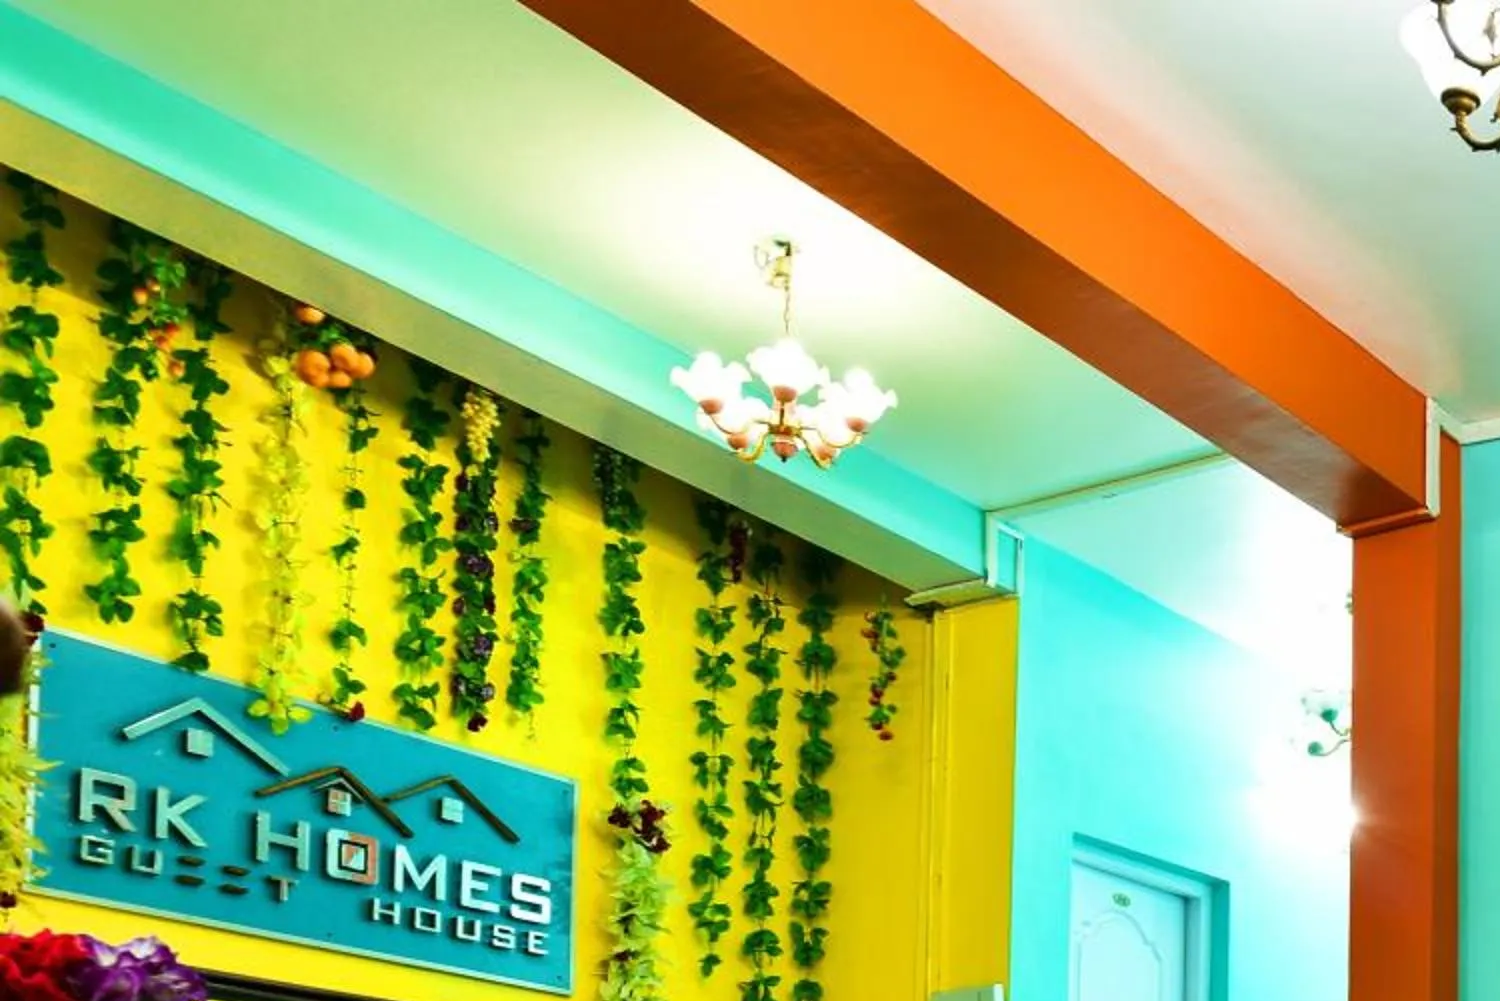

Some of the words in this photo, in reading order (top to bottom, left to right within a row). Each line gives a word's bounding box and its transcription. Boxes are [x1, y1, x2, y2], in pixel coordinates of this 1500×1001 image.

[78, 767, 208, 848] RK
[254, 808, 552, 925] HOMES
[79, 834, 299, 903] GUT
[372, 897, 549, 956] HOUSE
